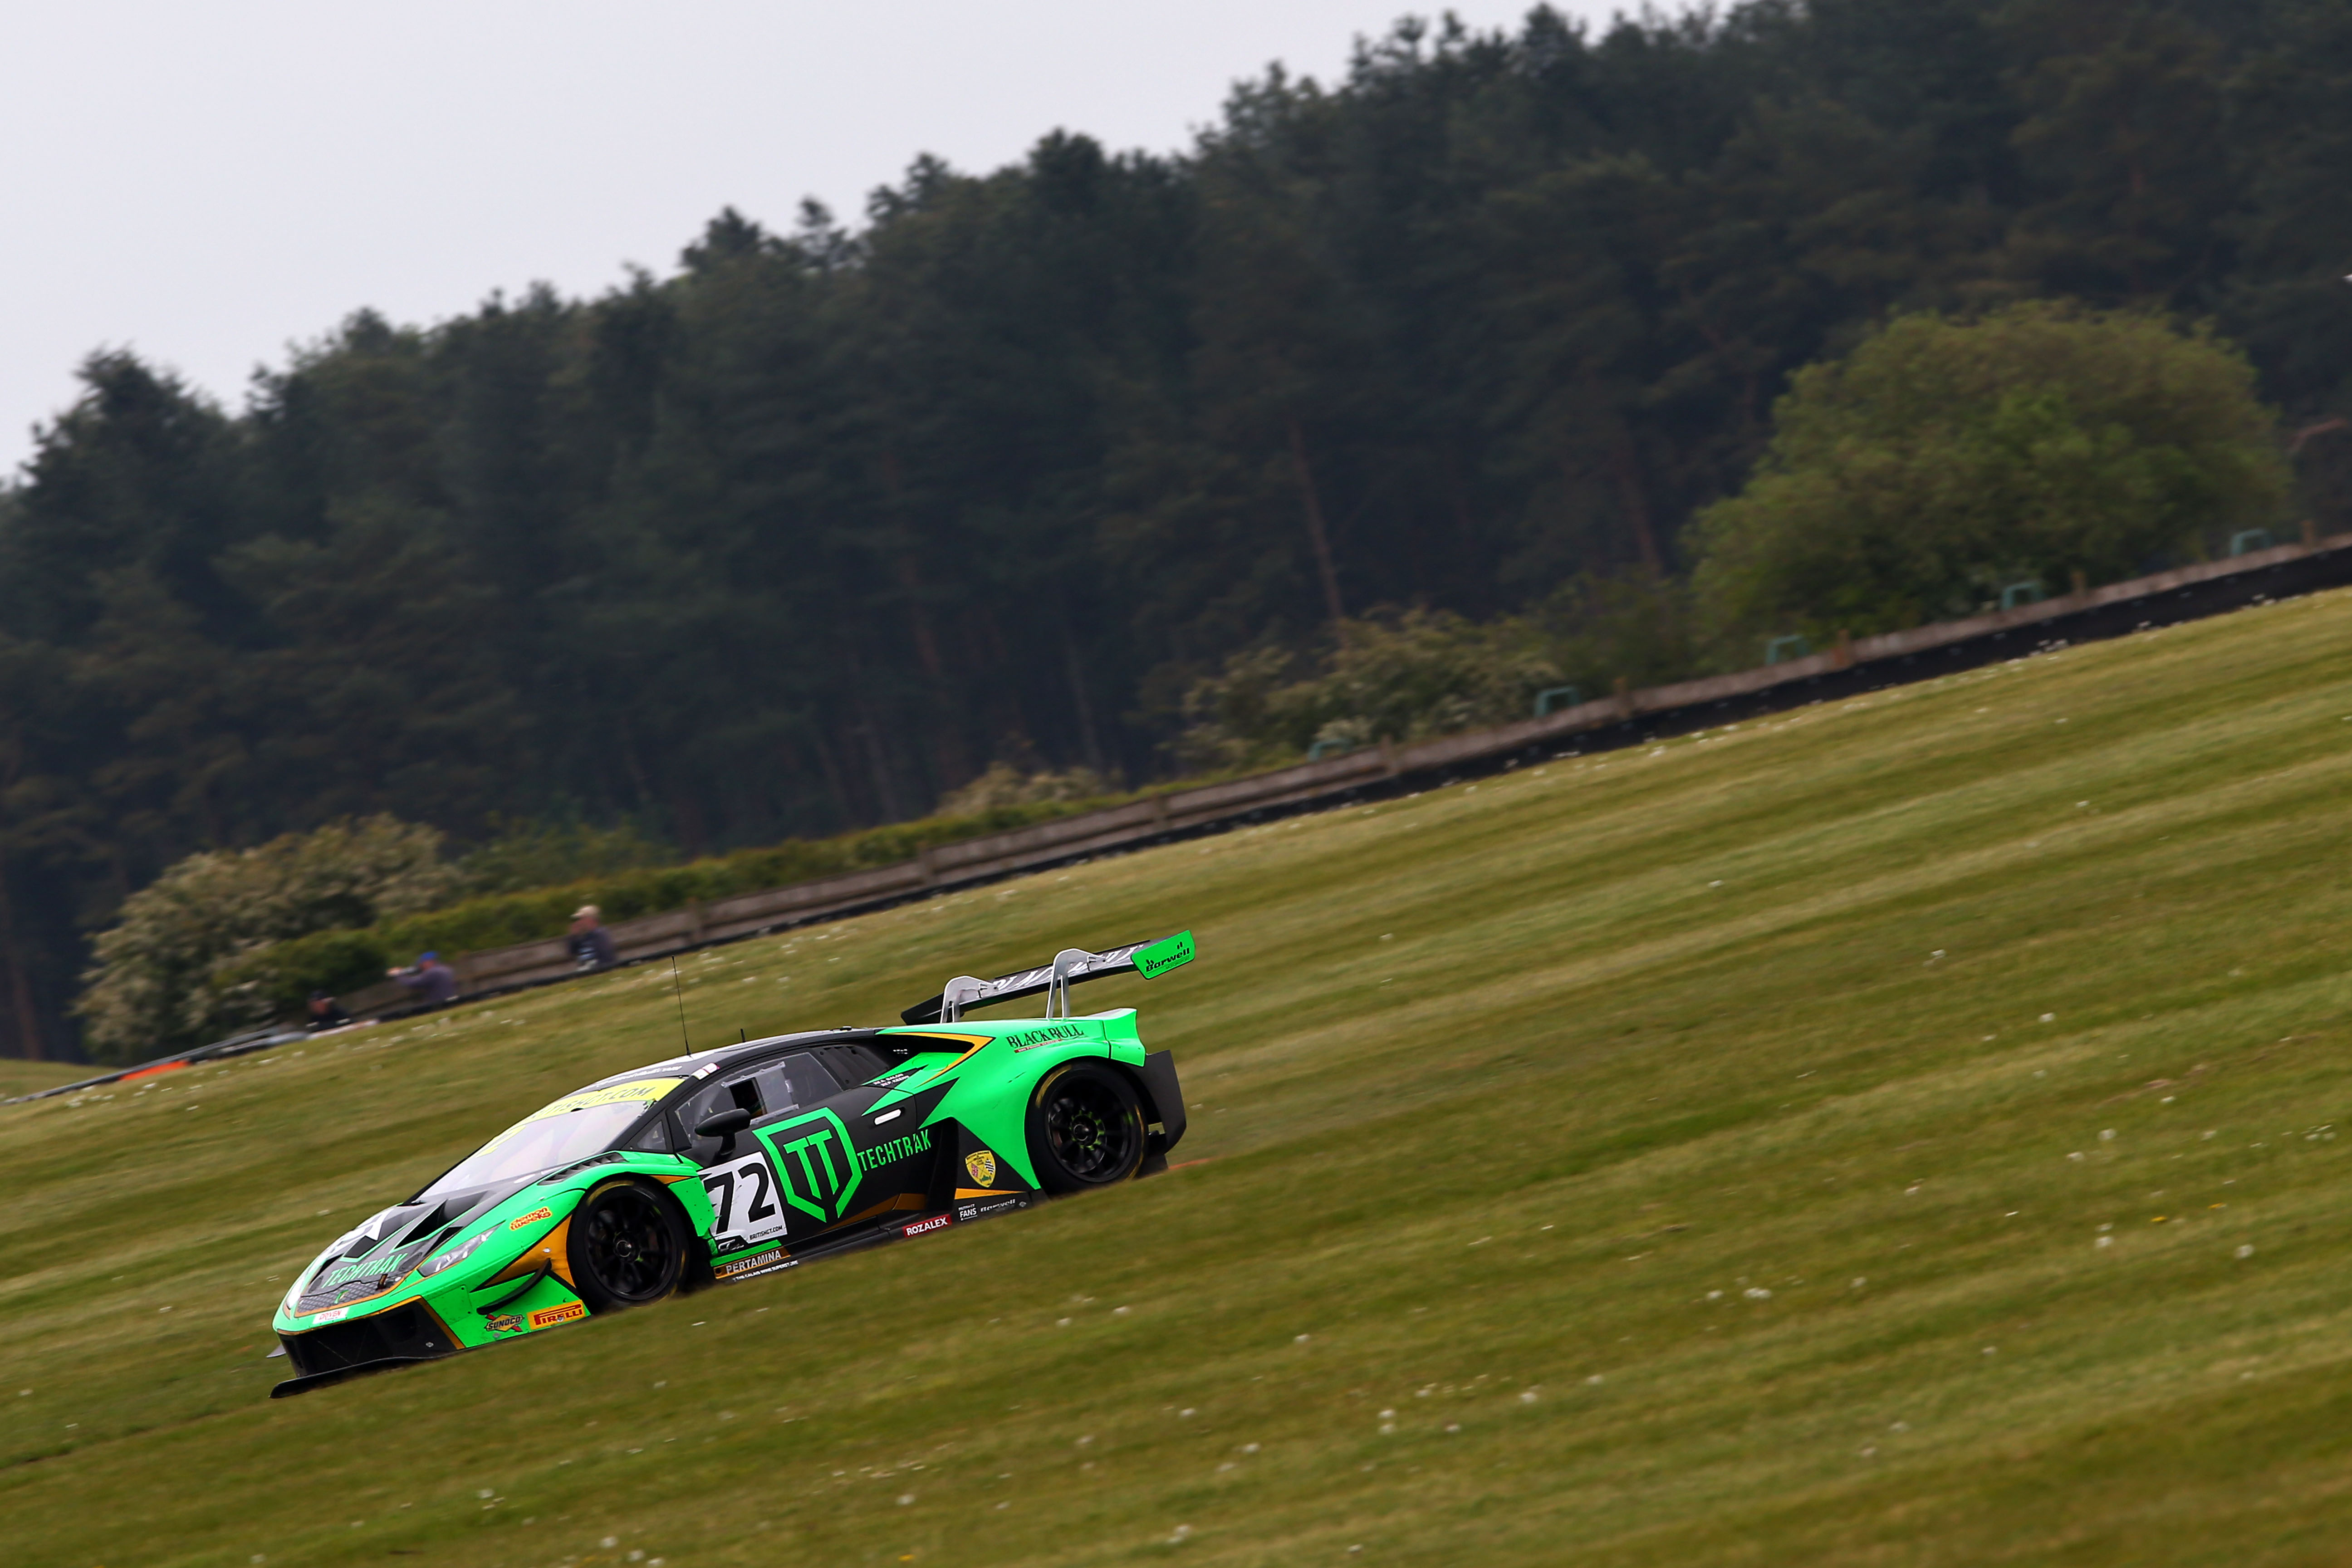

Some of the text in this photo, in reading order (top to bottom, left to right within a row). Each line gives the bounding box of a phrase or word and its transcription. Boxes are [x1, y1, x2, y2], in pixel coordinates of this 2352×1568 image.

[1146, 947, 1190, 972] Barwell
[1006, 1029, 1052, 1048] BLACK
[1047, 1024, 1085, 1039] BULL
[857, 1129, 931, 1171] TECHTRAK
[703, 1162, 776, 1235] 72
[960, 1208, 977, 1218] FANS
[750, 1225, 783, 1240] BRITISHGT.COM
[906, 1217, 948, 1236] ROZALEX
[321, 1253, 408, 1289] TECHTRAK
[726, 1250, 781, 1274] PERTAMINA
[488, 1316, 521, 1330] SUNOCO
[533, 1303, 583, 1325] PIRELLI
